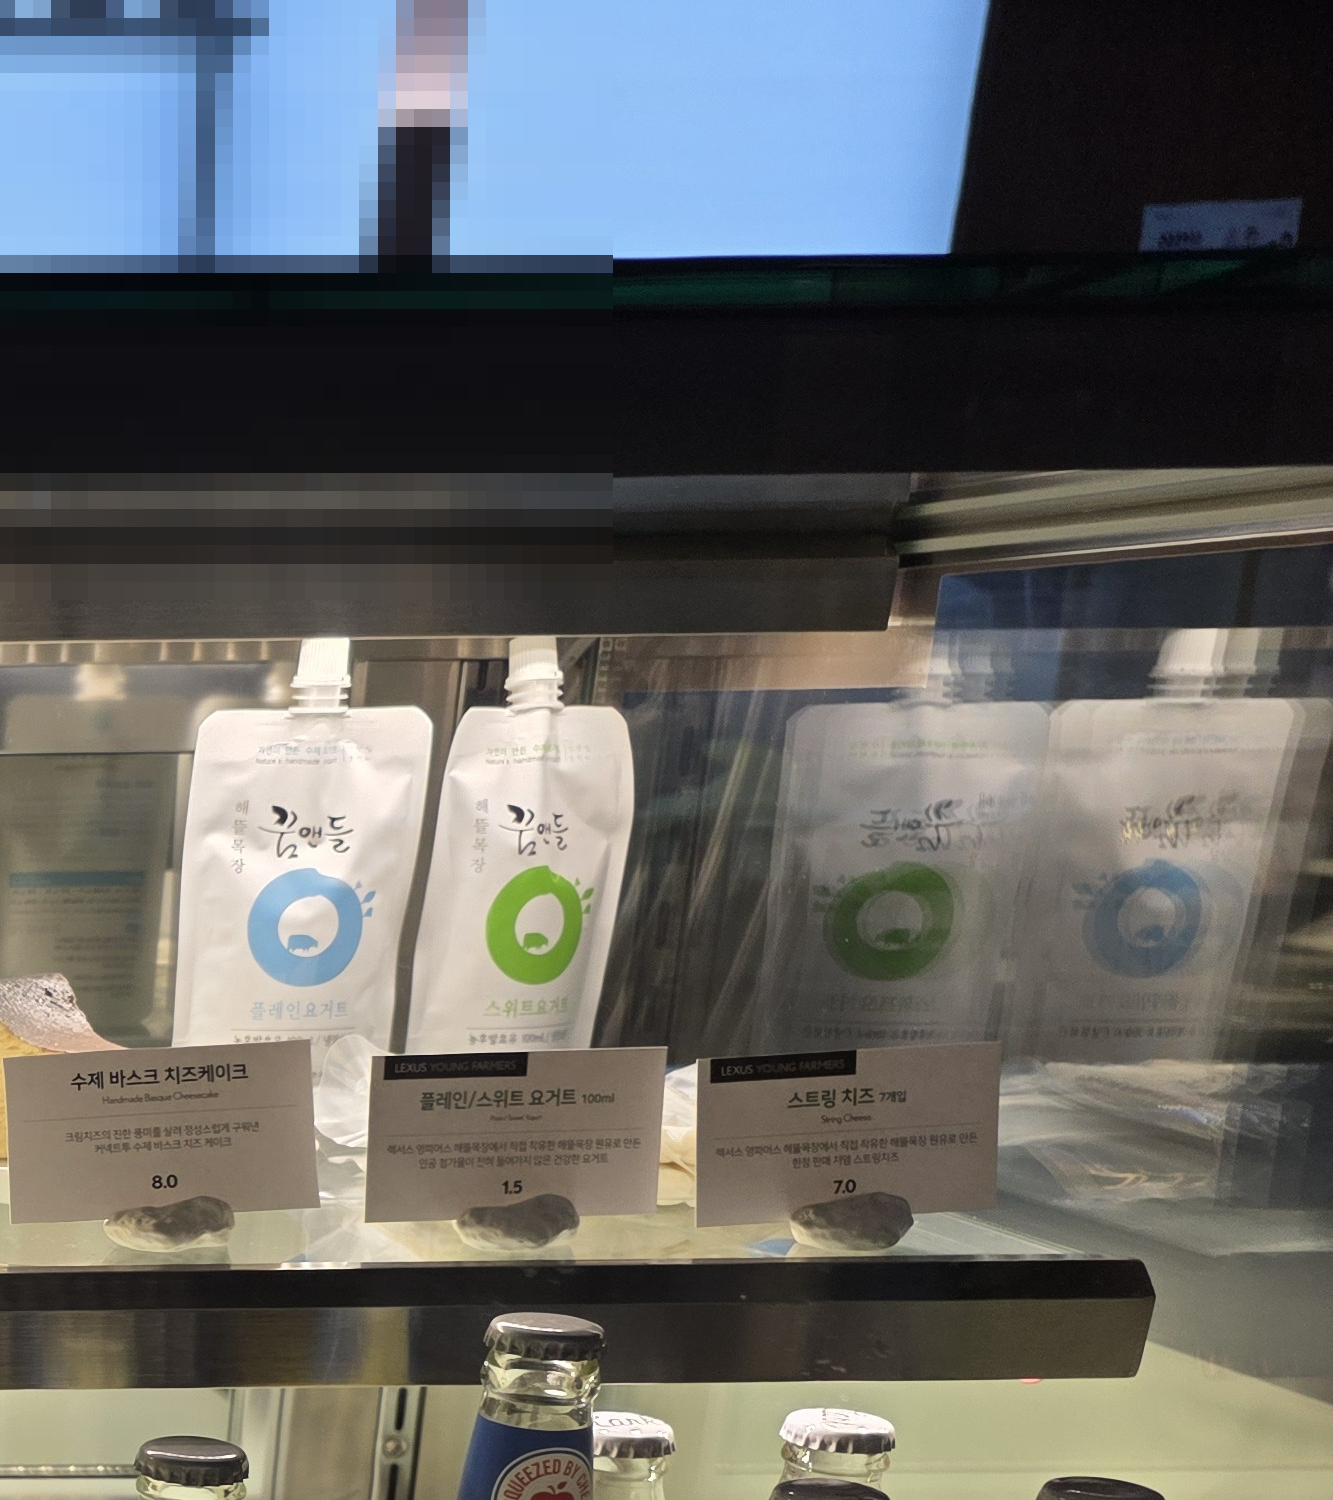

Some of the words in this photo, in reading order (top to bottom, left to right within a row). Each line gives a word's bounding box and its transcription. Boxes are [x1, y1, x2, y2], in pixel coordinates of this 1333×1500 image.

[257, 805, 354, 859] 꿈앤들
[498, 804, 569, 856] 꿈앤들
[70, 1070, 105, 1092] 수제
[109, 1068, 161, 1089] 바스크
[164, 1063, 249, 1085] 치즈케이크
[419, 1089, 525, 1111] 플레인/스위트
[527, 1087, 577, 1107] 요거트
[581, 1092, 616, 1105] 100ml
[786, 1088, 837, 1109] 스트링
[841, 1086, 875, 1107] 치즈
[878, 1090, 907, 1104] 7개입
[151, 1174, 178, 1190] 8.0
[501, 1179, 523, 1195] 1.5
[833, 1178, 857, 1195] 7.0
[563, 1460, 581, 1479] BY
